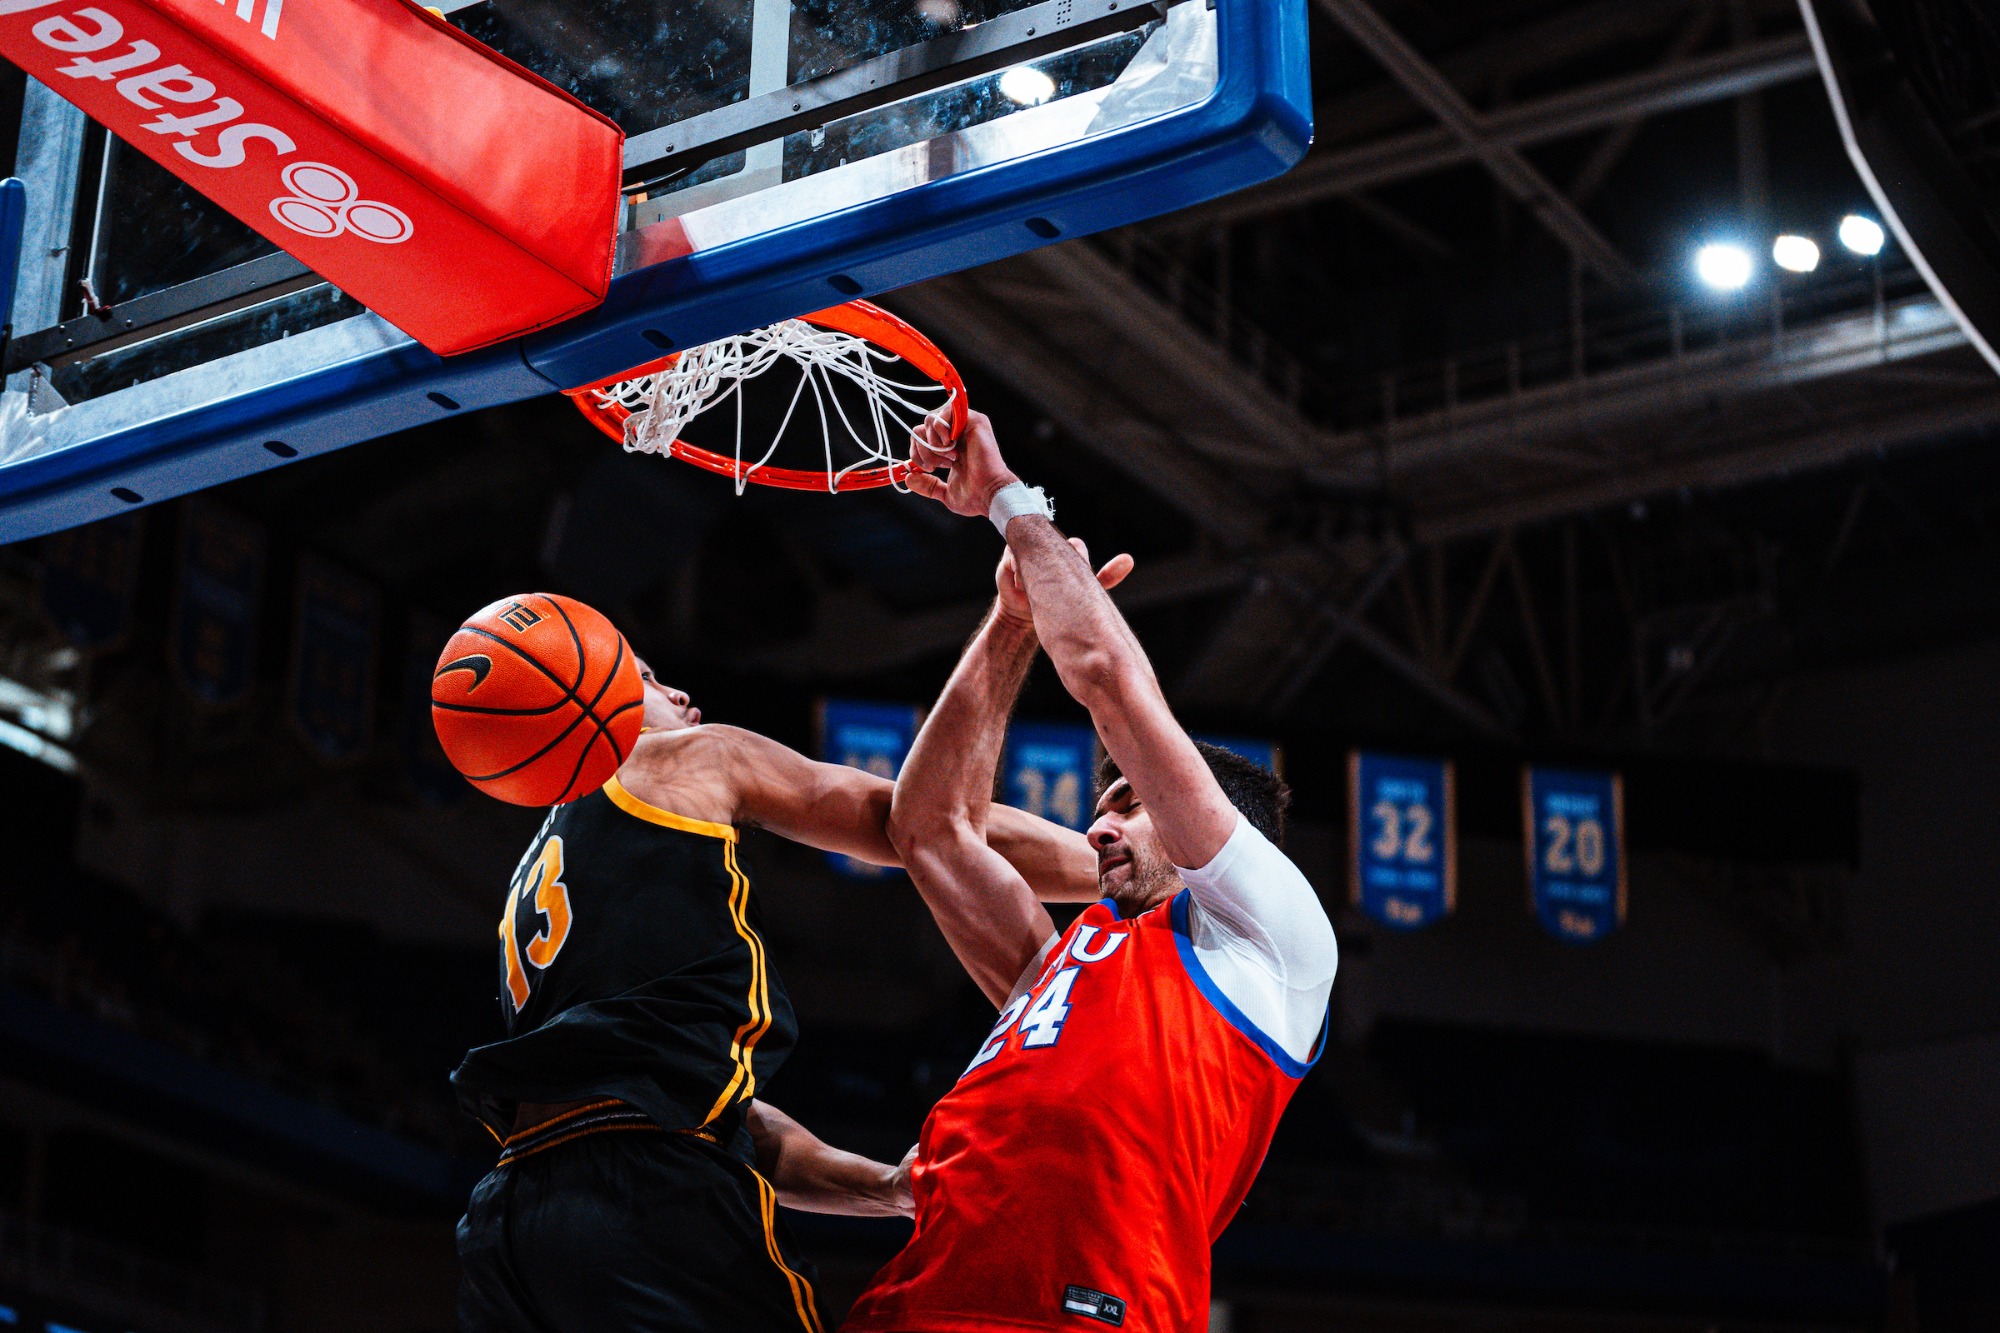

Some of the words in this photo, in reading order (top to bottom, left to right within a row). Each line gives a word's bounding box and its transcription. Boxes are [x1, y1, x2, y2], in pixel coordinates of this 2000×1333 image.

[31, 7, 297, 168] State
[1370, 801, 1434, 862] 32
[1544, 814, 1605, 876] 20
[502, 834, 573, 1015] 13
[960, 965, 1083, 1079] 24
